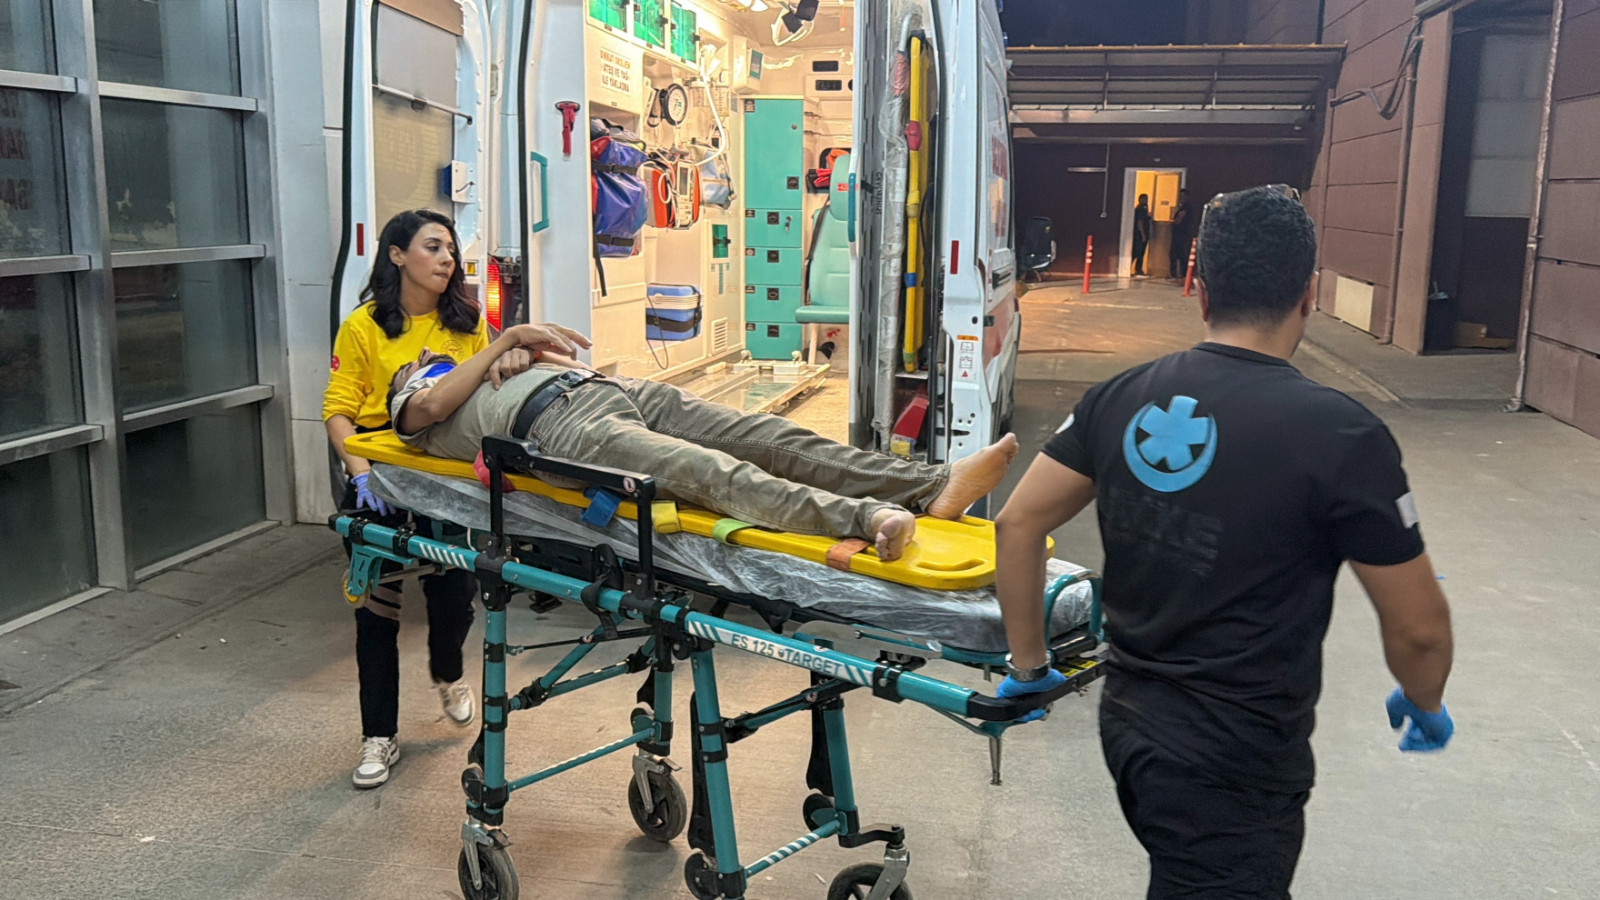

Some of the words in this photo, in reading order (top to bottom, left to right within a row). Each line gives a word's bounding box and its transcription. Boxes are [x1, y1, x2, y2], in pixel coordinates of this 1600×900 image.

[731, 633, 748, 649] ES
[753, 640, 775, 658] 125
[784, 648, 841, 676] TARGET
